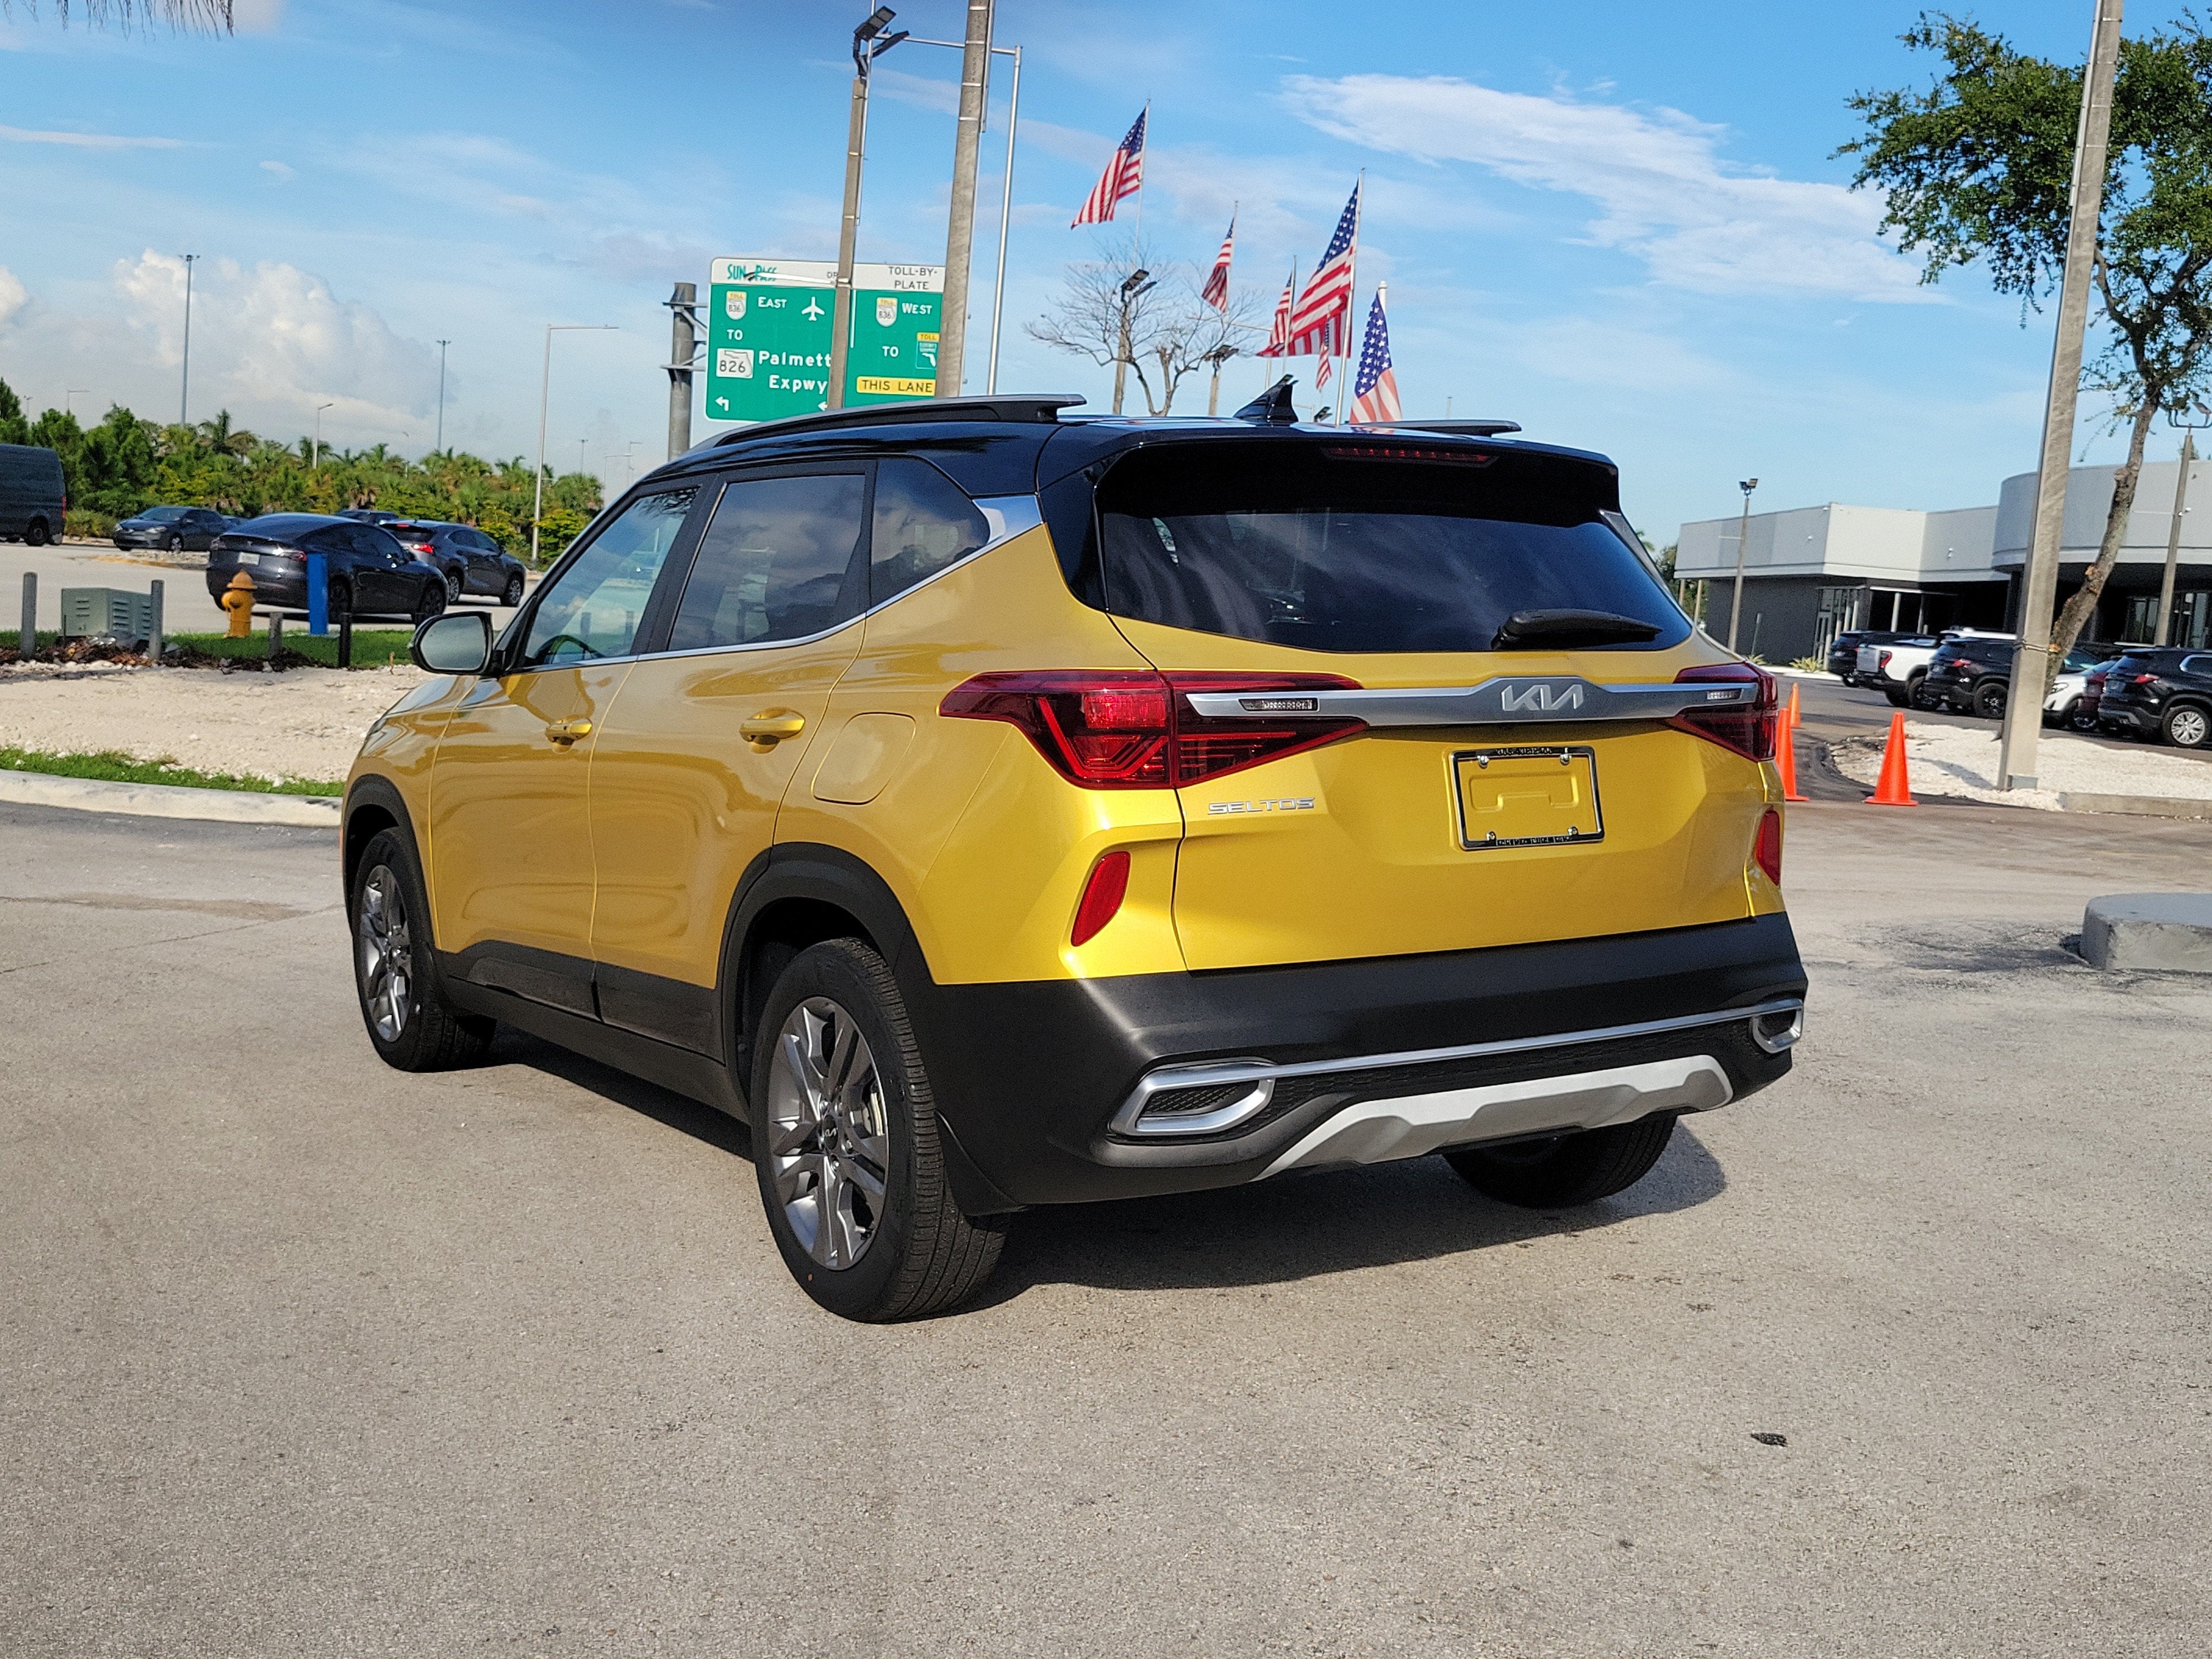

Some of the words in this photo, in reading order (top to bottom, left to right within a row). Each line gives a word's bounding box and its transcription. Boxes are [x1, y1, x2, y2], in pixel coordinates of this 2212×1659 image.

[727, 264, 746, 280] SUN
[894, 280, 929, 290] PLATE
[758, 296, 787, 308] EAST
[901, 303, 932, 314] WEST
[727, 329, 743, 340] TO
[882, 346, 899, 357] TO
[759, 350, 832, 368] Palmett
[720, 360, 746, 373] 826
[769, 374, 828, 394] Expwy
[862, 380, 890, 391] THIS
[898, 381, 933, 393] LANE
[1501, 684, 1583, 711] KIA
[1207, 797, 1315, 815] SELTOS
